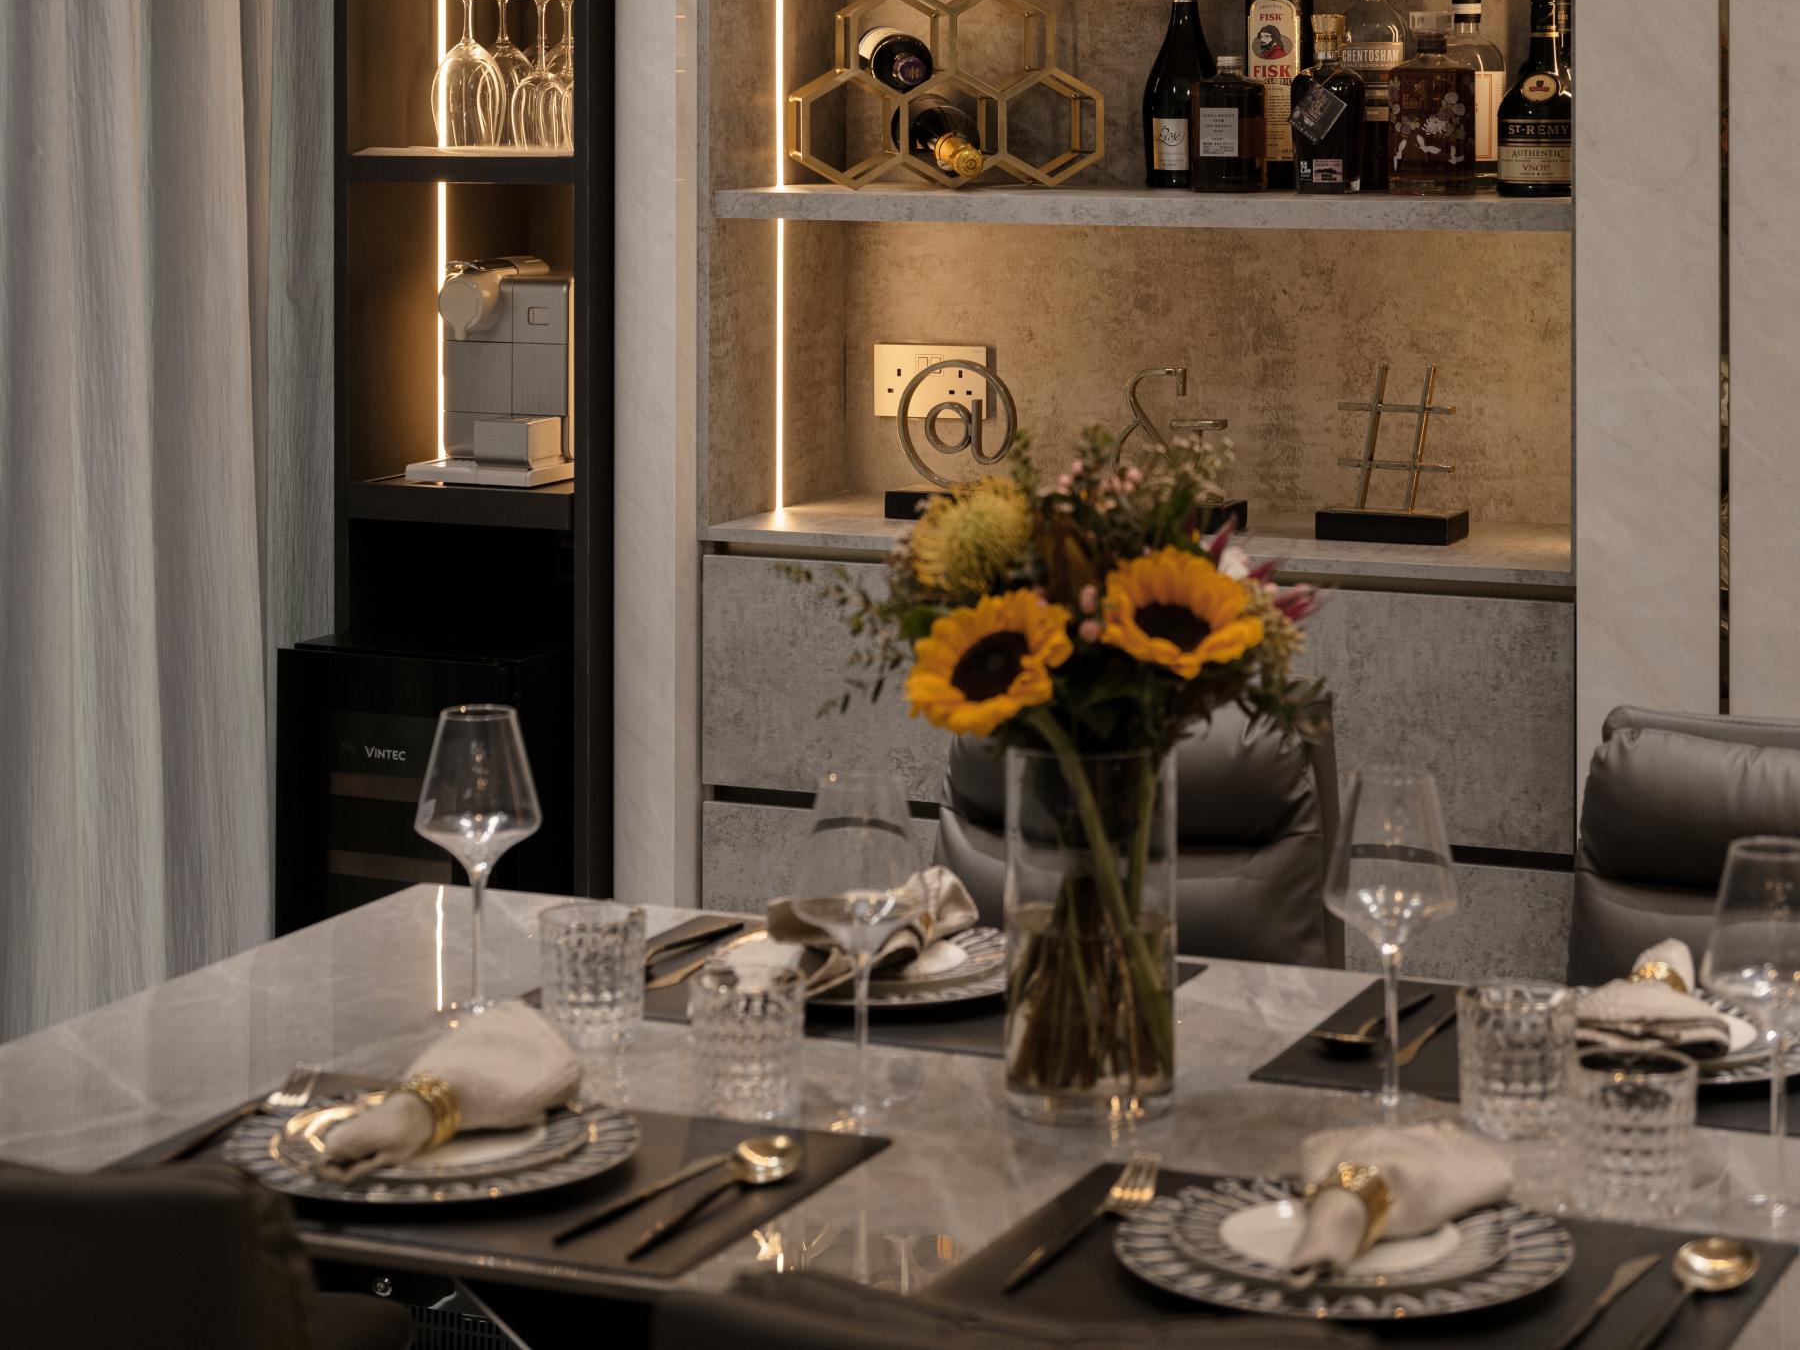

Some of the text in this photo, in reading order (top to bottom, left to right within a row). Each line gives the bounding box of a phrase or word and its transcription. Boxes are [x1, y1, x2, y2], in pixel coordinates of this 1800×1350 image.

[1260, 13, 1282, 22] FISK
[1253, 65, 1291, 78] FISK
[1511, 149, 1565, 159] AUTHENTIC
[364, 745, 407, 761] VINTEC
